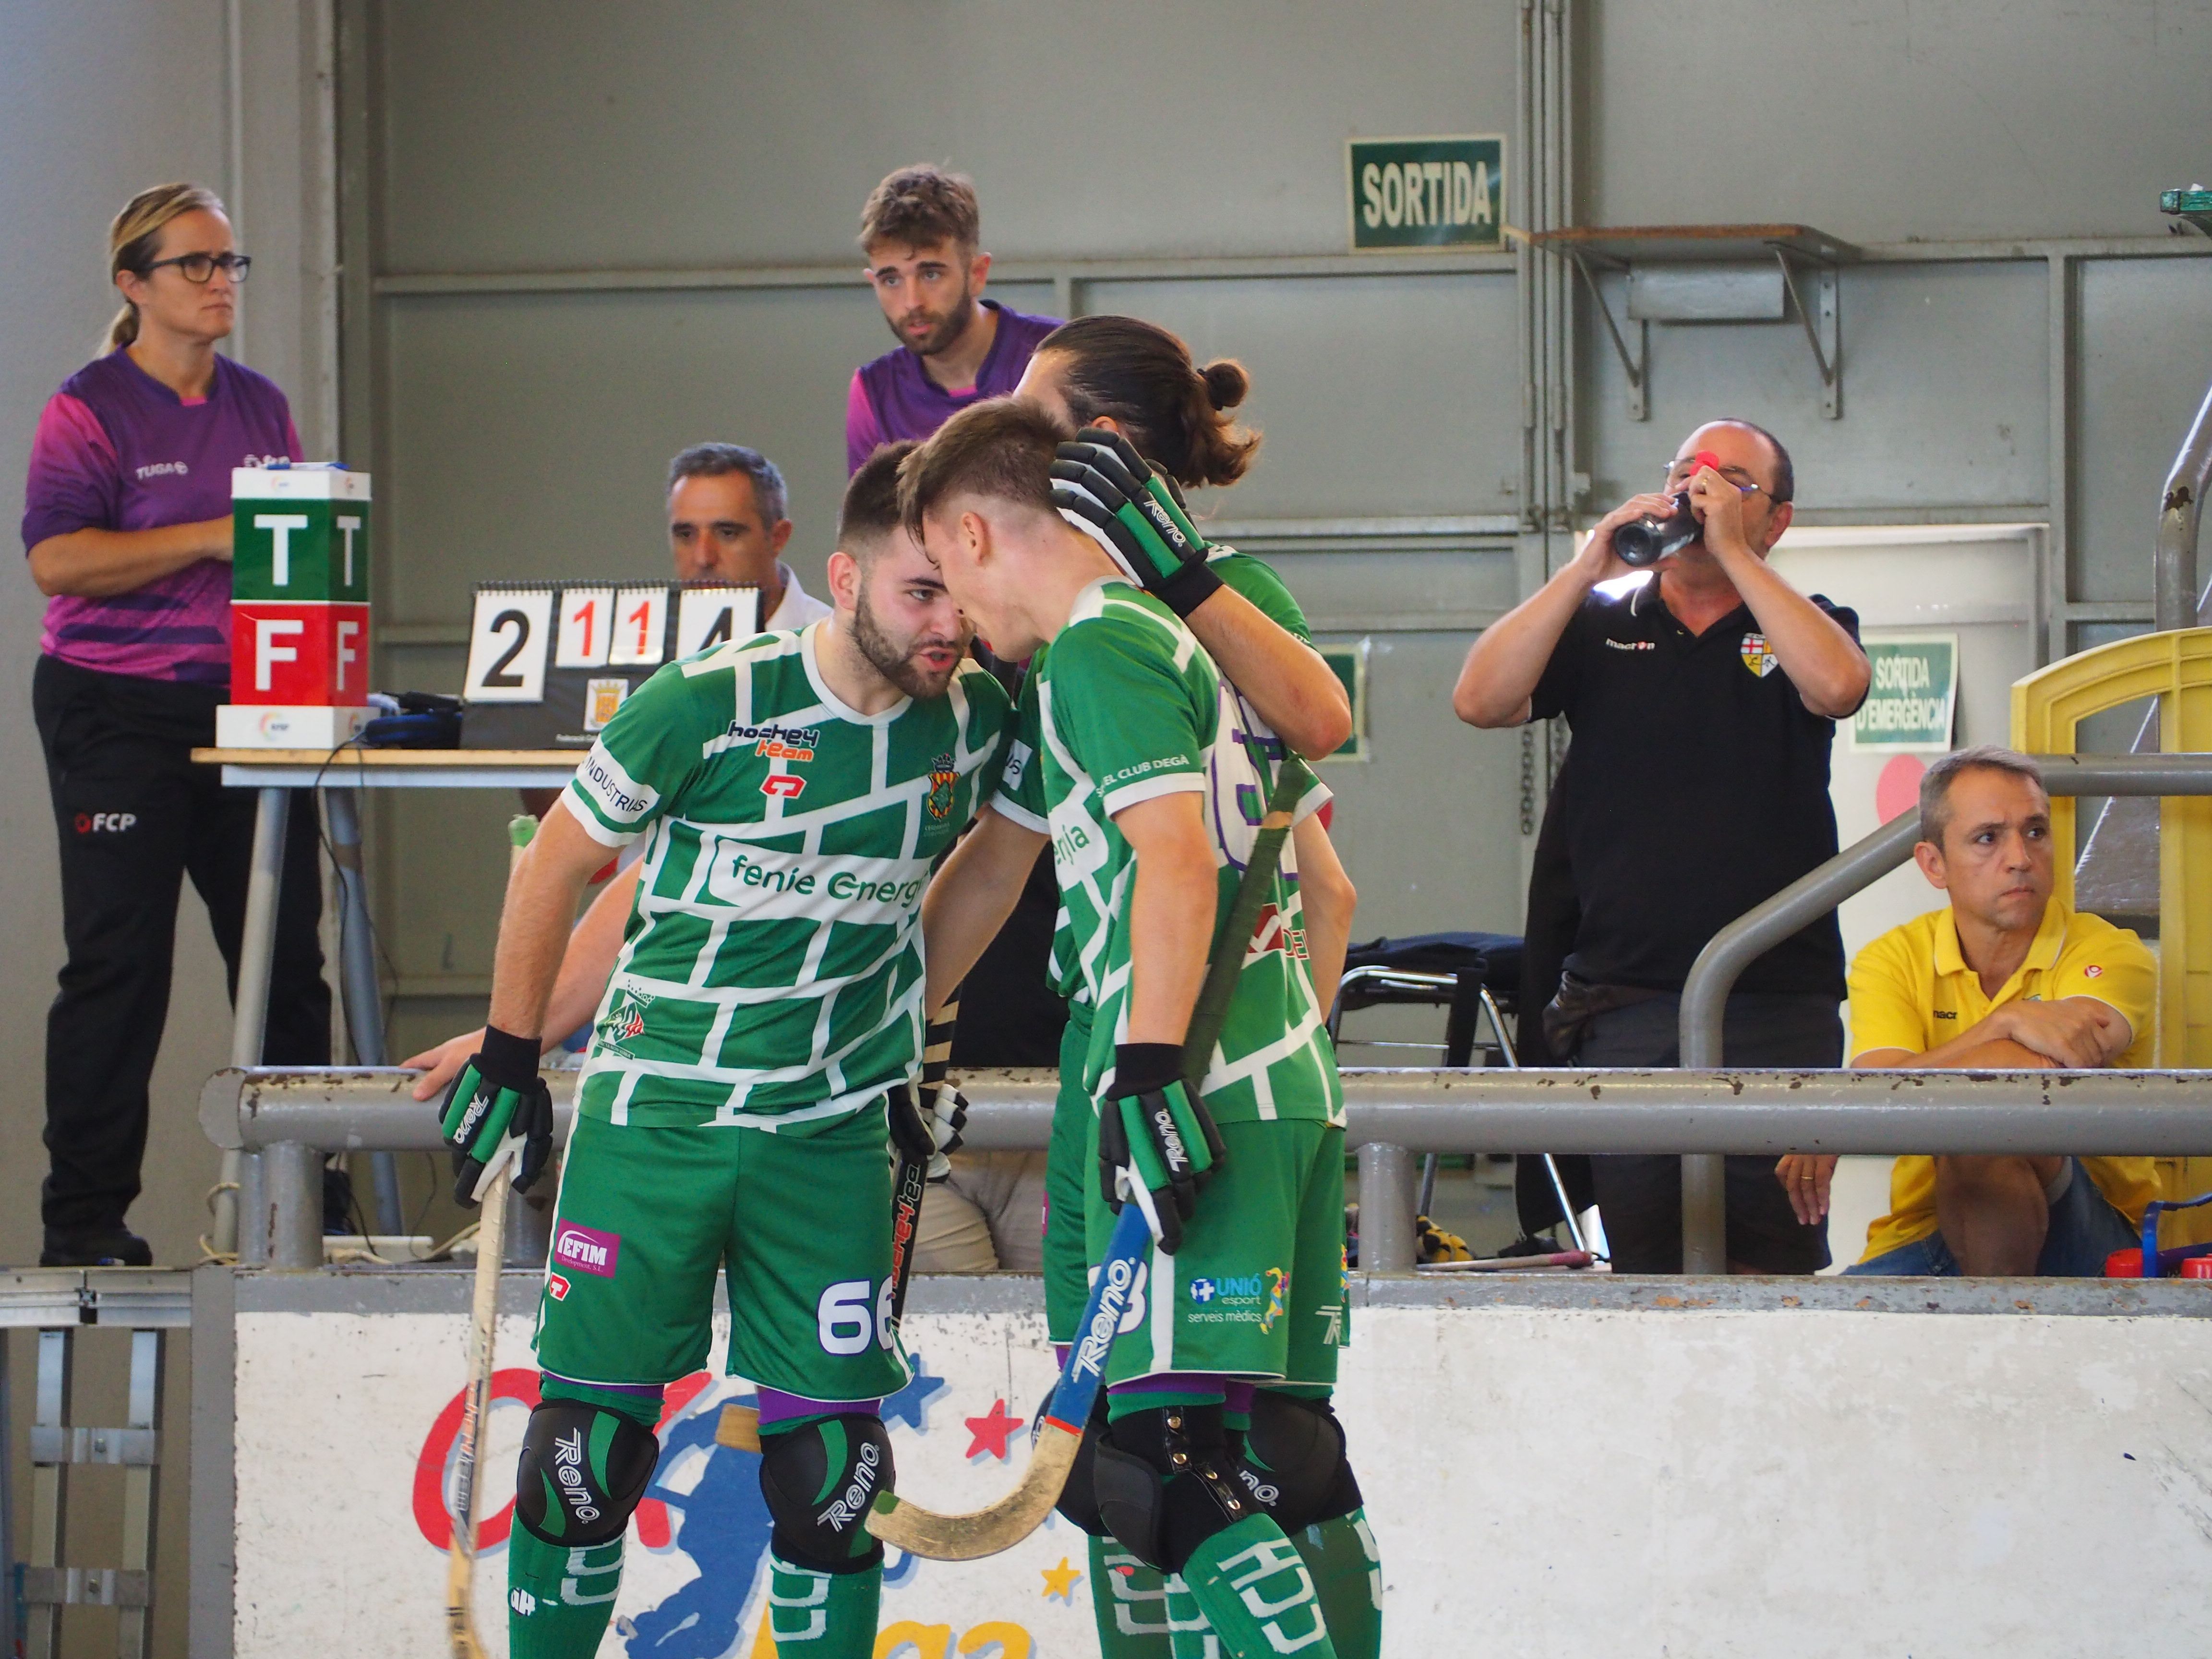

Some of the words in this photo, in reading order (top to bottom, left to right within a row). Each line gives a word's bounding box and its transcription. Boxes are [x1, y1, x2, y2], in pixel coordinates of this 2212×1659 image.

[1362, 161, 1491, 228] SORTIDA
[1143, 491, 1186, 543] Reno
[253, 514, 309, 586] T
[337, 515, 361, 587] T
[255, 619, 304, 691] F
[337, 621, 359, 691] F
[480, 609, 529, 687] 2
[574, 601, 595, 657] 1
[629, 600, 649, 655] 1
[1606, 637, 1655, 650] macron
[1875, 656, 1931, 690] SORTIDA
[727, 720, 819, 747] hockey
[755, 739, 814, 762] team
[585, 756, 648, 812] INDUSTRIAS
[1117, 761, 1152, 779] CLUB
[1152, 754, 1190, 769] DEGÀ
[92, 812, 137, 832] FCP
[733, 854, 816, 895] fenie
[453, 1092, 489, 1144] Reno
[1154, 1111, 1189, 1172] Reno
[1216, 1273, 1262, 1296] UNIÓ
[1221, 1296, 1261, 1306] esport
[1071, 1259, 1132, 1383] Reno
[1188, 1310, 1224, 1323] serveis
[1225, 1310, 1262, 1322] mèdics
[555, 1427, 600, 1521] Reno
[817, 1442, 879, 1532] Reno
[1239, 1470, 1280, 1503] no
